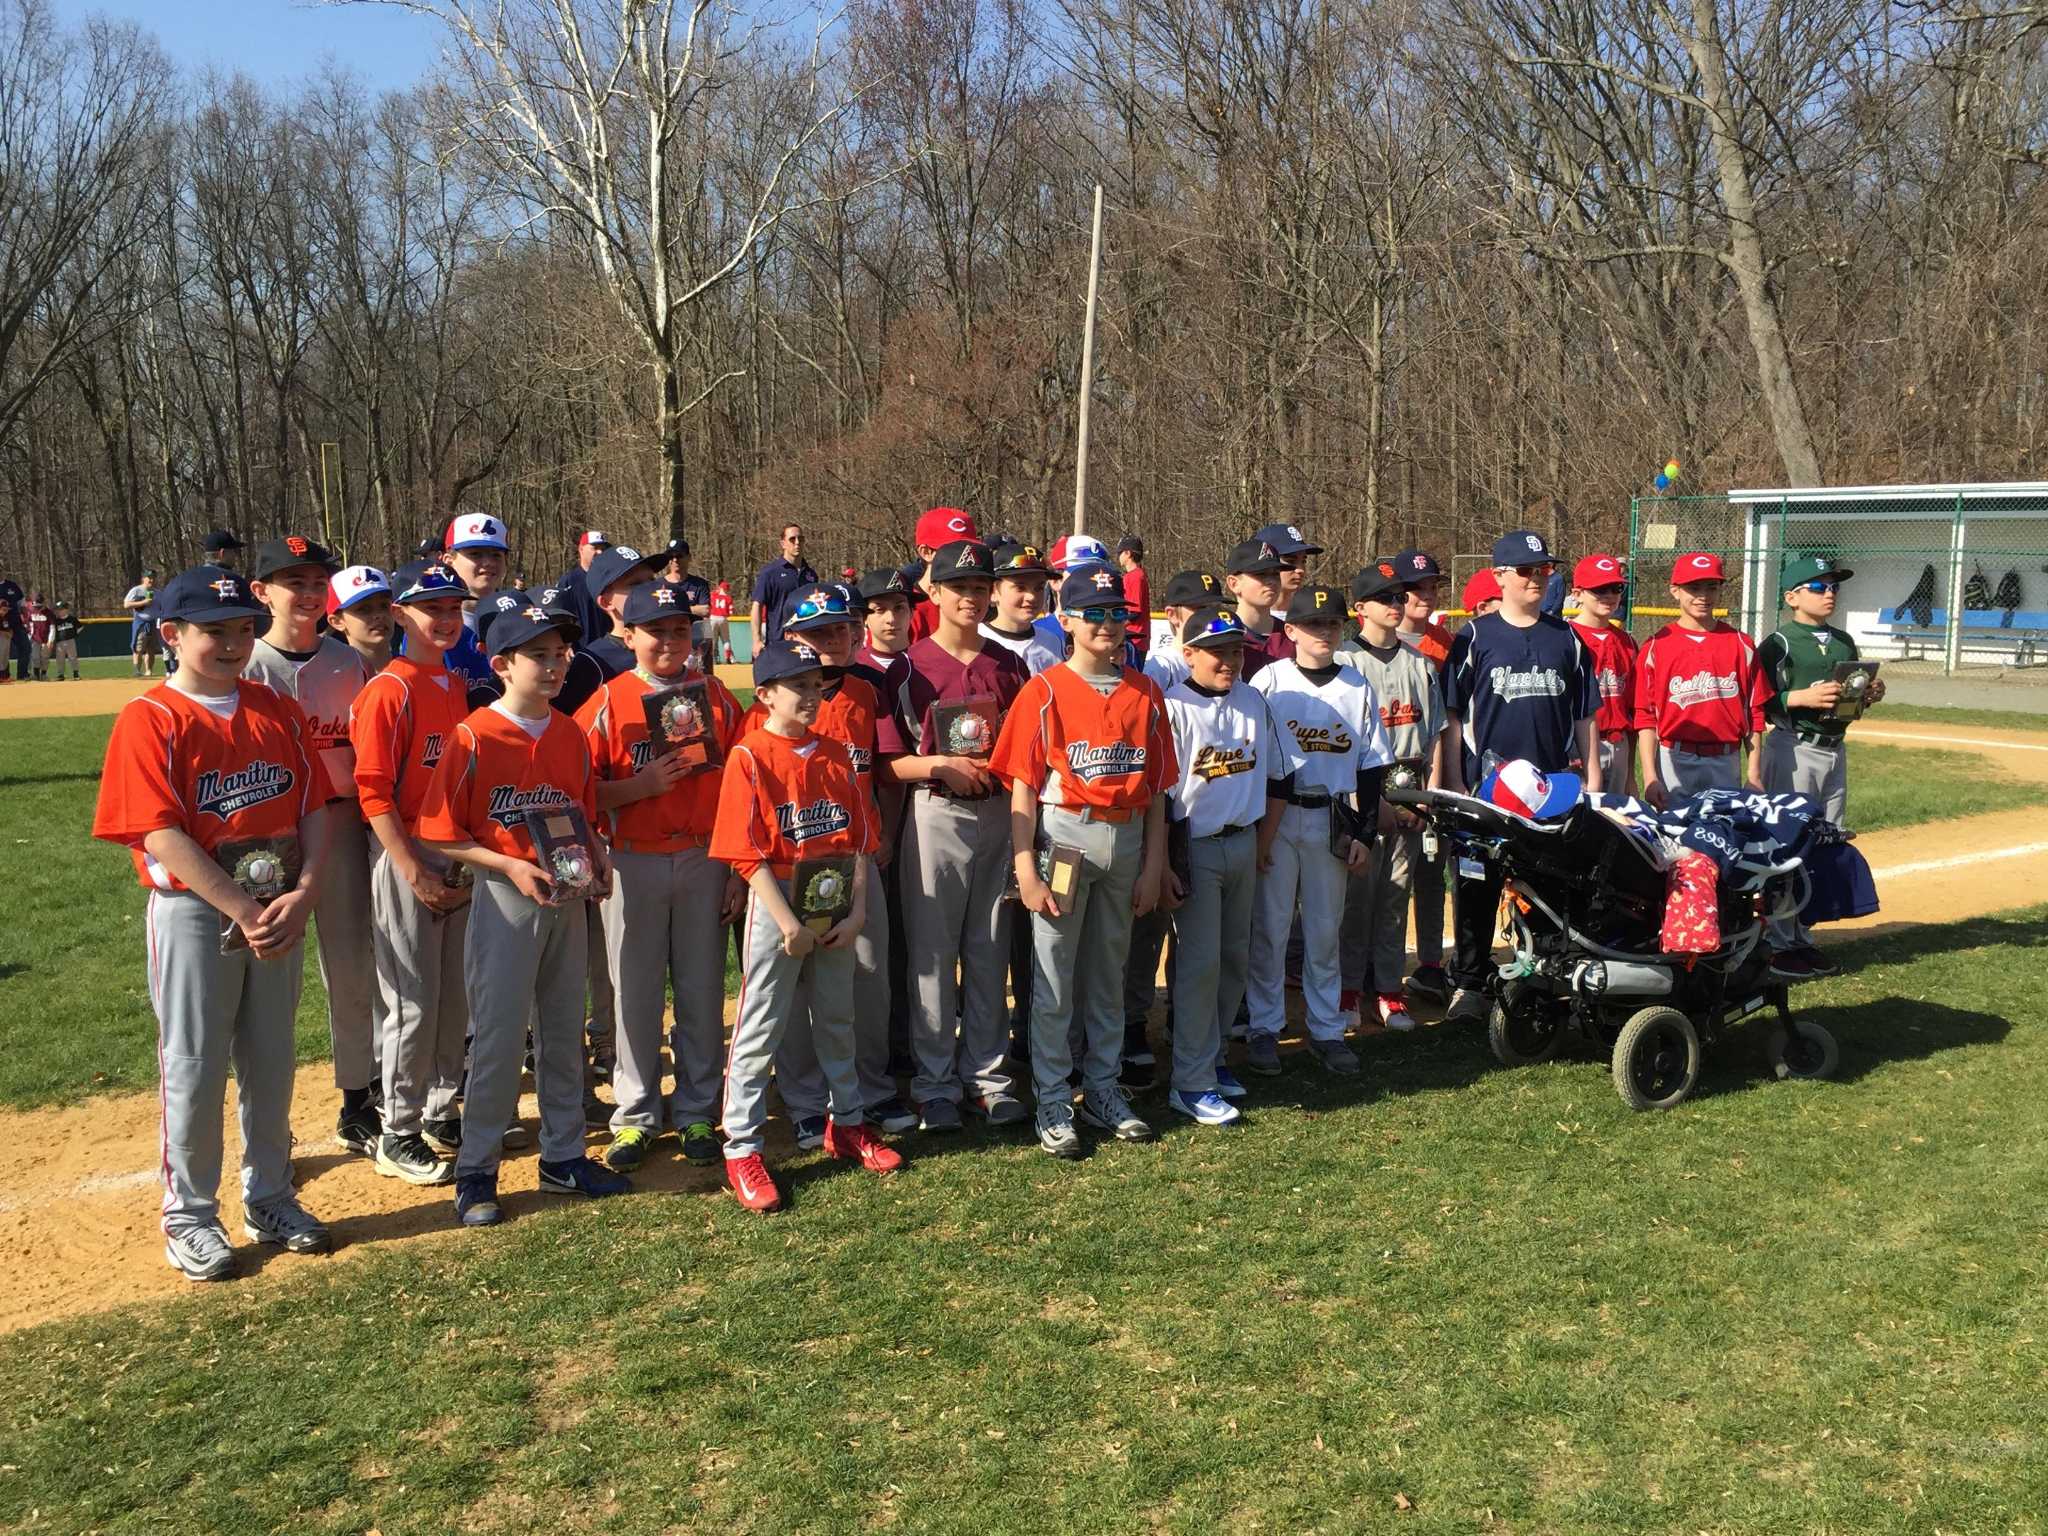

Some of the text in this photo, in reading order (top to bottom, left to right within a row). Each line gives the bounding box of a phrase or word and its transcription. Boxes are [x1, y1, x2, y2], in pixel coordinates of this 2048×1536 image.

[947, 517, 968, 533] C
[1596, 559, 1615, 571] C
[1692, 556, 1712, 569] C
[1201, 574, 1214, 592] P
[1314, 591, 1328, 609] P
[1066, 740, 1146, 768] Maritime
[1084, 764, 1130, 778] CHEVROLET
[196, 759, 285, 806] Maritim
[218, 784, 281, 813] CHEVROLET
[776, 799, 845, 830] Maritim
